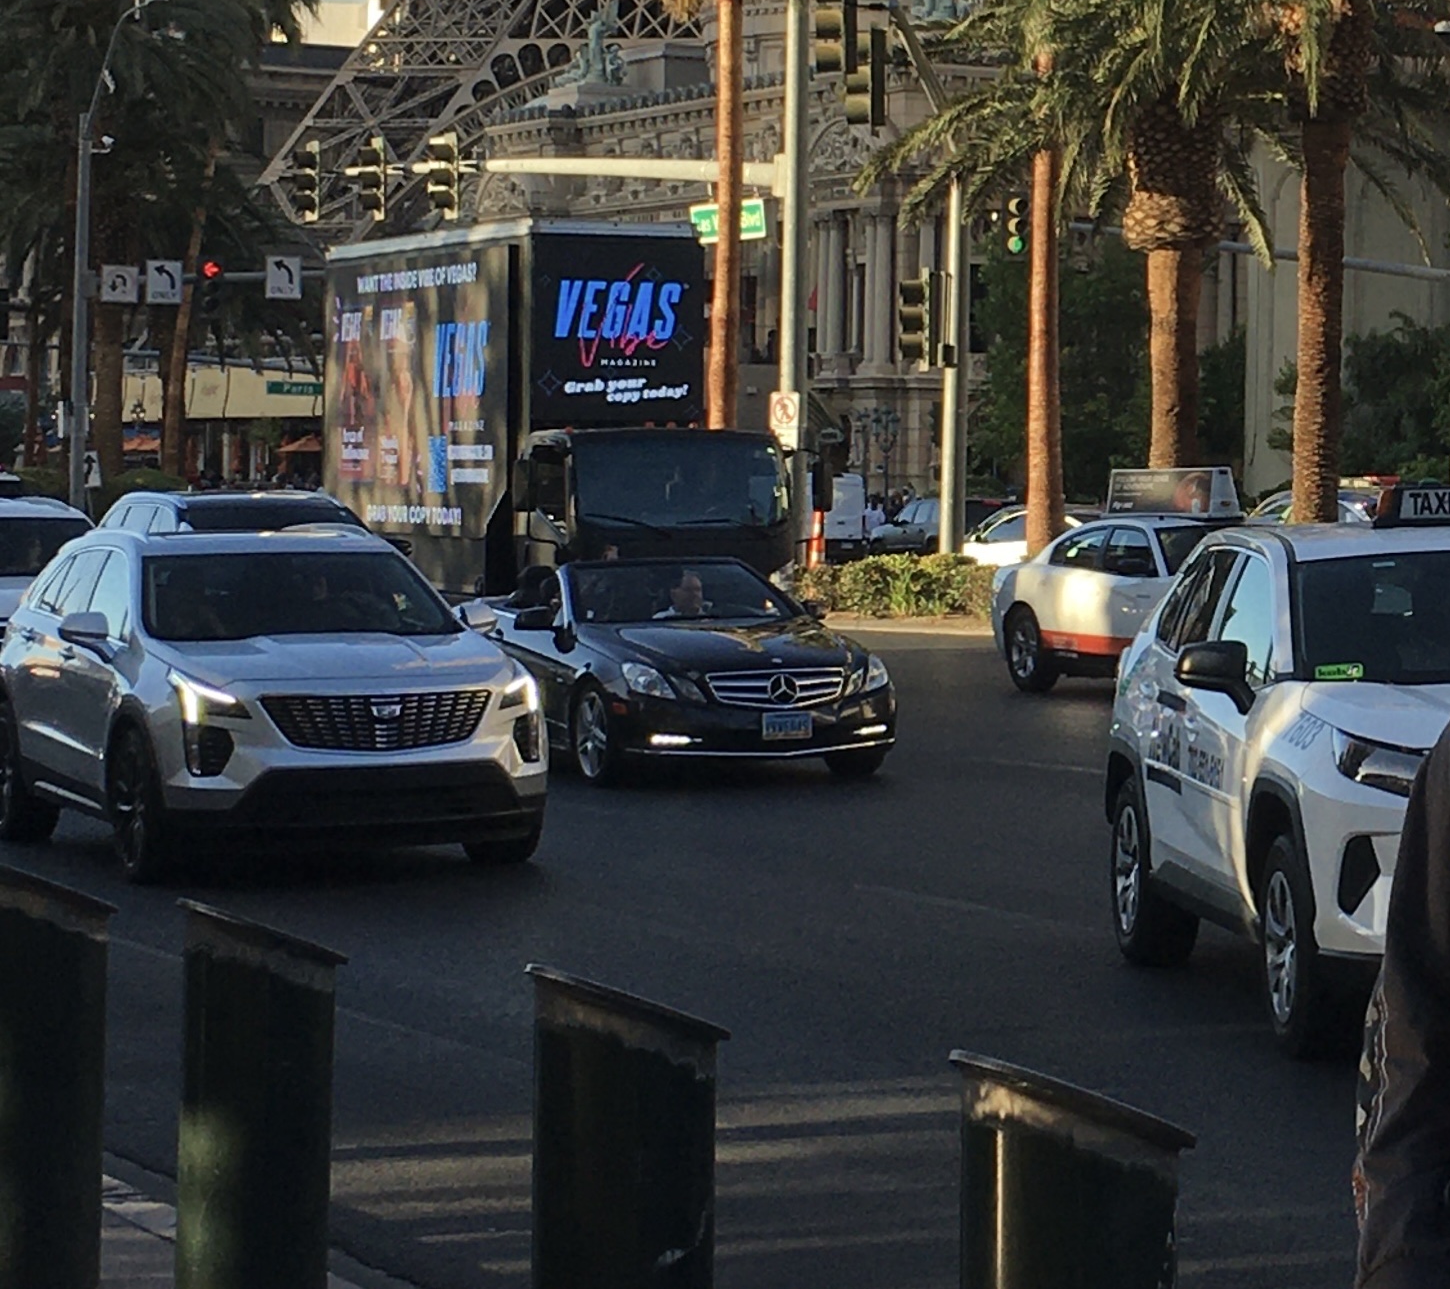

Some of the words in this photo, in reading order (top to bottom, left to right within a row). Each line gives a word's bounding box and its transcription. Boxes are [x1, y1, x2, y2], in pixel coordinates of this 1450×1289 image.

[435, 266, 446, 286] OF
[152, 291, 177, 300] ONLY
[270, 286, 295, 295] ONLY
[555, 279, 682, 339] VEGAS
[434, 321, 487, 398] VEGAS
[600, 358, 656, 367] MAGAZINE
[564, 378, 605, 394] Grab
[606, 378, 647, 393] your
[606, 391, 641, 403] copy
[642, 384, 689, 400] today!
